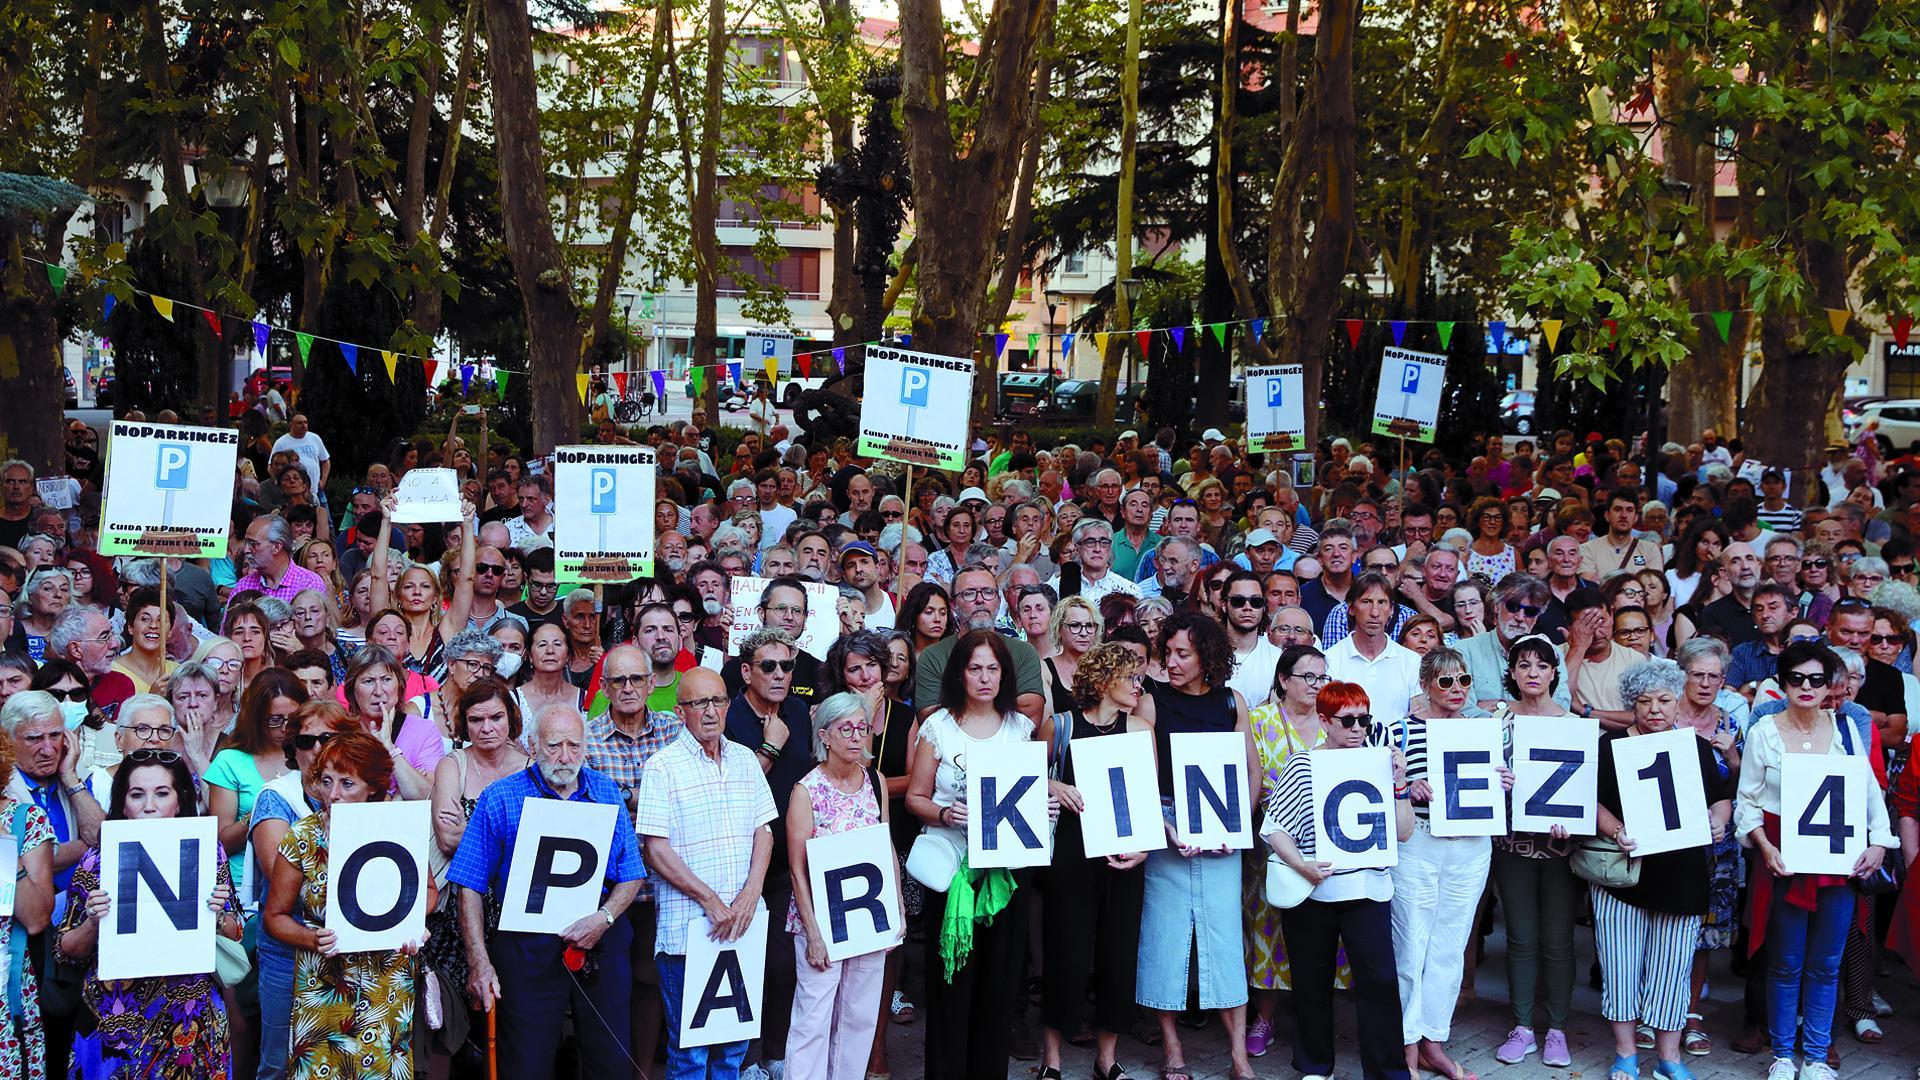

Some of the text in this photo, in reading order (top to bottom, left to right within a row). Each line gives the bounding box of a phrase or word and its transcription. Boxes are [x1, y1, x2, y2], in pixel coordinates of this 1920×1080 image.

[903, 370, 927, 398] P
[1268, 380, 1280, 402] P
[1403, 366, 1419, 388] P
[160, 447, 187, 481] P
[593, 471, 614, 506] P
[980, 775, 1044, 851] K
[1107, 766, 1133, 838] I
[1184, 763, 1242, 834] N
[1322, 779, 1388, 853] G
[1443, 750, 1494, 820] E
[1524, 747, 1585, 819] Z
[1636, 751, 1682, 831] 1
[1797, 774, 1855, 855] 4
[116, 838, 199, 935] N
[336, 840, 420, 932] O
[523, 835, 599, 914] P
[824, 862, 891, 943] R
[688, 949, 755, 1030] A
